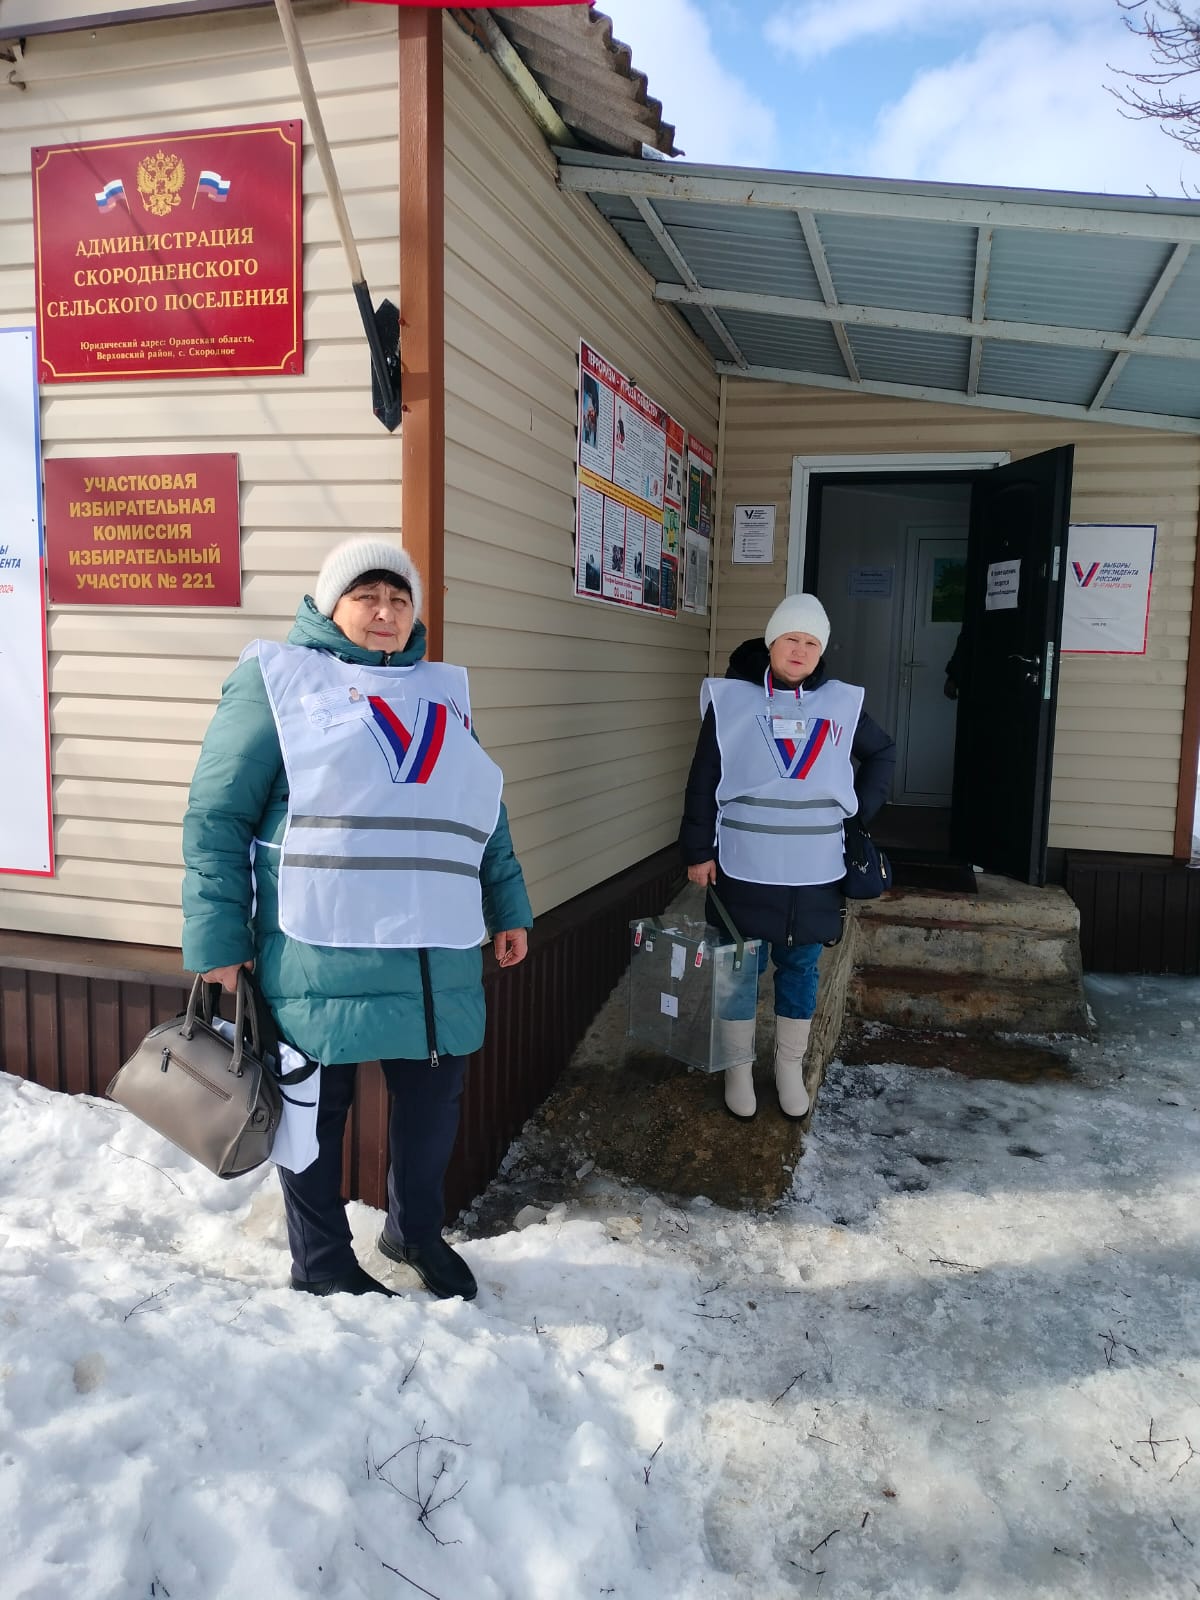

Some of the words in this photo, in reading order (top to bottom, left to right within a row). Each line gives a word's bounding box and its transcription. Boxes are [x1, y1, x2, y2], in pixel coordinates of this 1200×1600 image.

[75, 227, 254, 258] АДМИНИСТРАЦИЯ
[74, 258, 259, 287] СКОРОДНЕНСКОГО
[46, 294, 158, 318] СЕЛЬСКОГО
[164, 287, 290, 312] ПОСЕЛЕНИЯ
[80, 339, 138, 351] Юридический
[140, 338, 166, 349] адрес:
[169, 336, 216, 347] Орловская
[96, 349, 145, 361] Верховский
[188, 346, 236, 357] Скородное
[84, 472, 198, 493] УЧАСТКОВАЯ
[69, 497, 216, 518] ИЗБИРАТЕЛЬНАЯ
[93, 523, 192, 541] КОМИССИЯ
[69, 543, 221, 566] ИЗБИРАТЕЛЬНЫЙ
[76, 574, 153, 590] УЧАСТОК
[157, 573, 178, 589] №
[181, 573, 215, 589] 221
